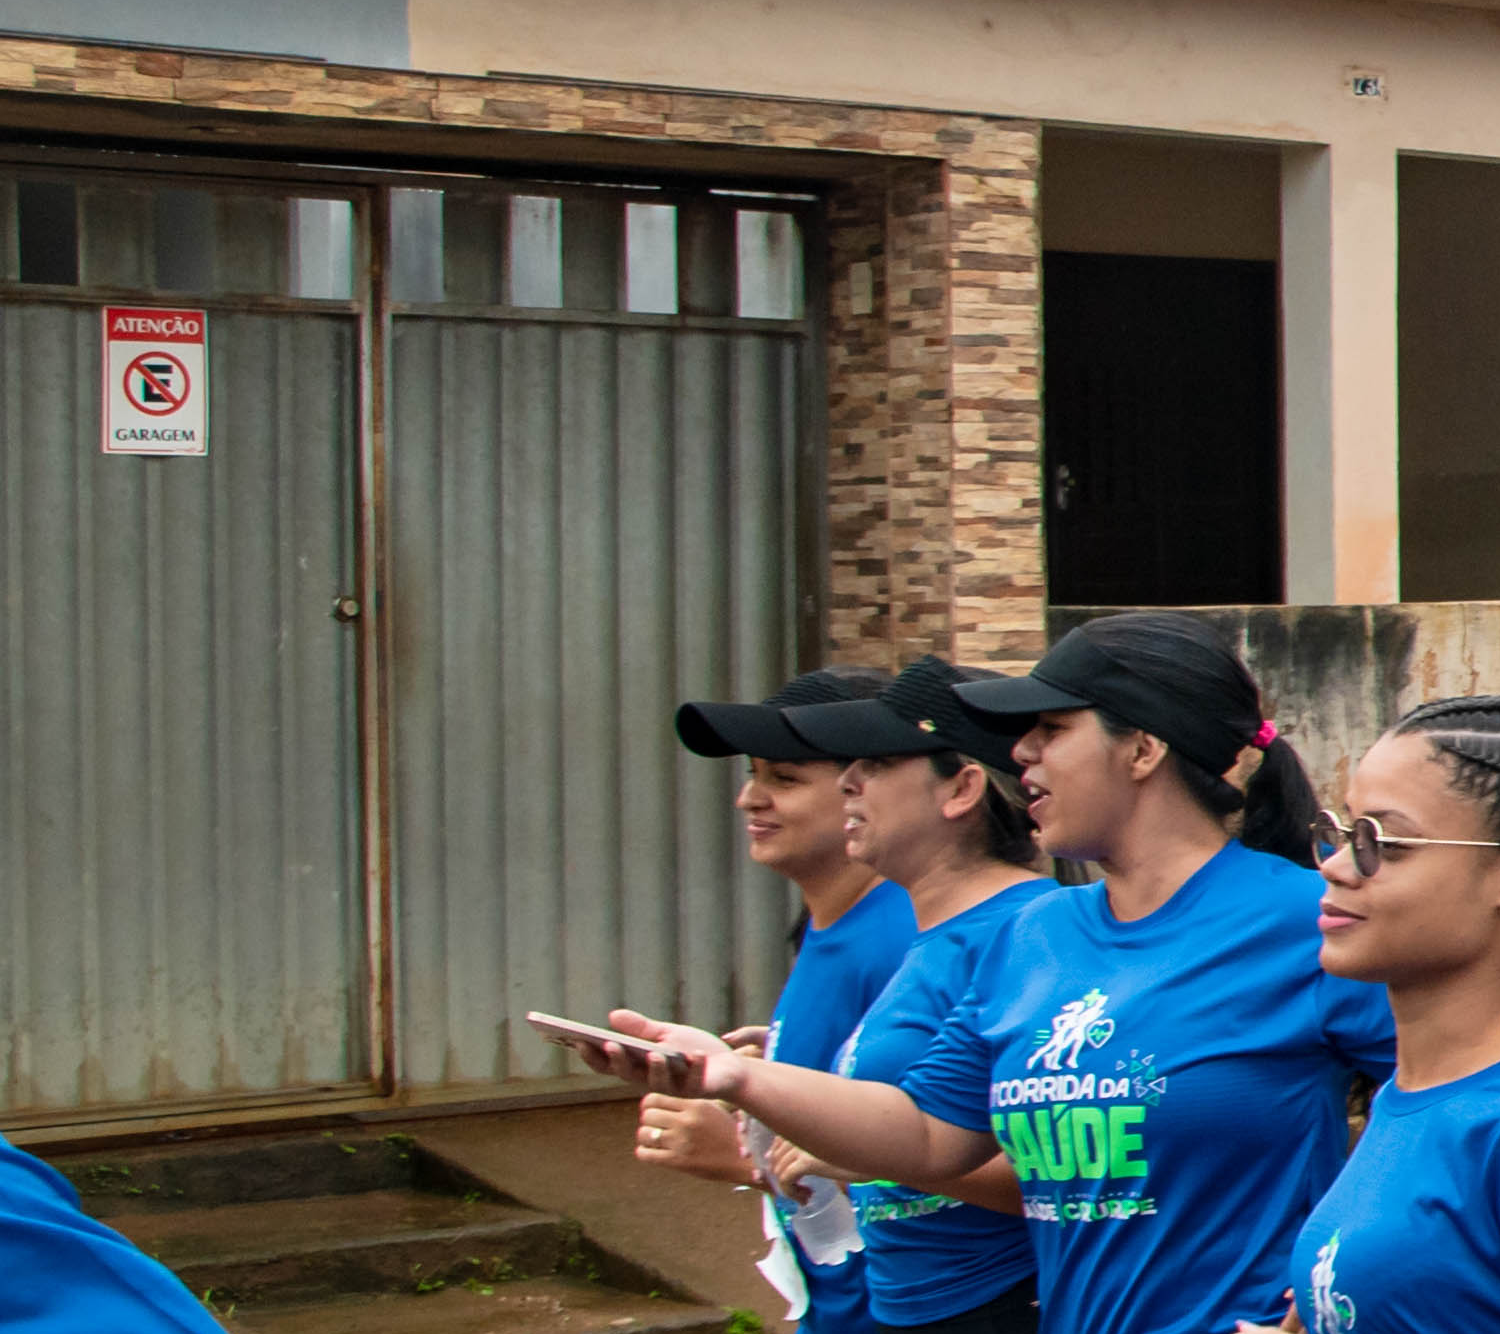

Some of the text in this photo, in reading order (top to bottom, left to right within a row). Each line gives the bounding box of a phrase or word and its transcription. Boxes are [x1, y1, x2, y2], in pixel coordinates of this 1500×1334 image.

[113, 316, 200, 338] ATENÇÃO
[115, 428, 196, 442] GARAGEM
[1098, 1078, 1130, 1099] DA
